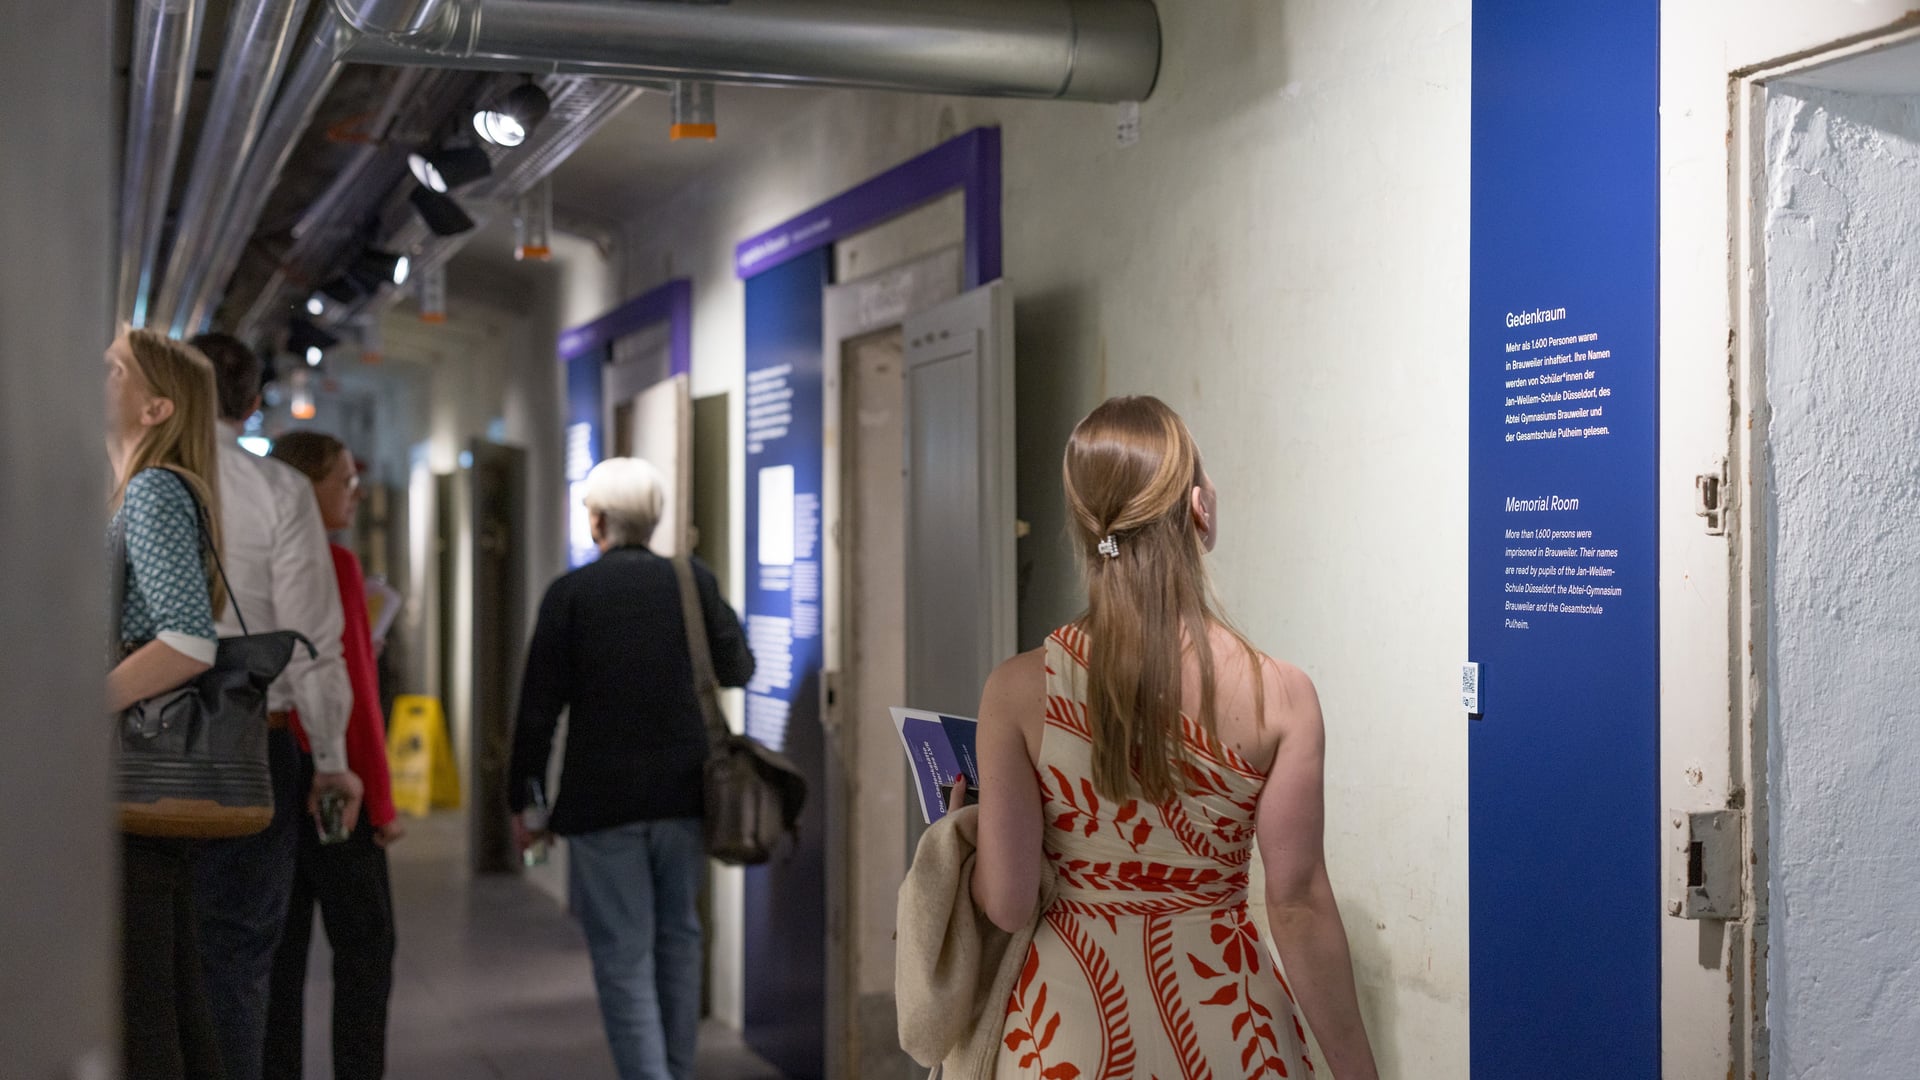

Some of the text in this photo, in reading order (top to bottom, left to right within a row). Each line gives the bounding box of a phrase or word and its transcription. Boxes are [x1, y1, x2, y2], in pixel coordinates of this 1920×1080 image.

[1506, 308, 1566, 328] Gedenkraum
[1506, 332, 1598, 352] Mehr als 1.600 Personen waren
[1506, 349, 1610, 370] in Brauweiler inhaftiert. Ihre Namen
[1505, 377, 1526, 388] werden
[1528, 376, 1538, 385] von
[1584, 370, 1595, 380] der
[1505, 388, 1611, 407] Jan-Wellem-Schule Düsseldorf, des
[1505, 406, 1603, 424] Abtei Gymnasiums Brauweiler und
[1505, 426, 1610, 442] der Gesamtschule Pulheim gelesen.
[1505, 495, 1579, 512] Memorial Room
[1505, 529, 1520, 539] More
[1521, 529, 1534, 538] than
[1535, 529, 1550, 538] 1,600
[1552, 530, 1576, 540] persons
[1505, 547, 1618, 558] imprisoned in Brauweiler. Their names
[1515, 566, 1529, 575] read
[1529, 566, 1537, 577] by
[1538, 566, 1556, 577] pupils
[1557, 566, 1565, 575] of
[1566, 566, 1576, 576] the
[1576, 566, 1615, 577] Jan-Wellem-
[1505, 583, 1622, 597] Schule Düsseldorf, the Abtei-Gymnasium
[1505, 601, 1603, 614] Brauweiler and the Gesamtschule
[1505, 618, 1530, 629] Pulheim.
